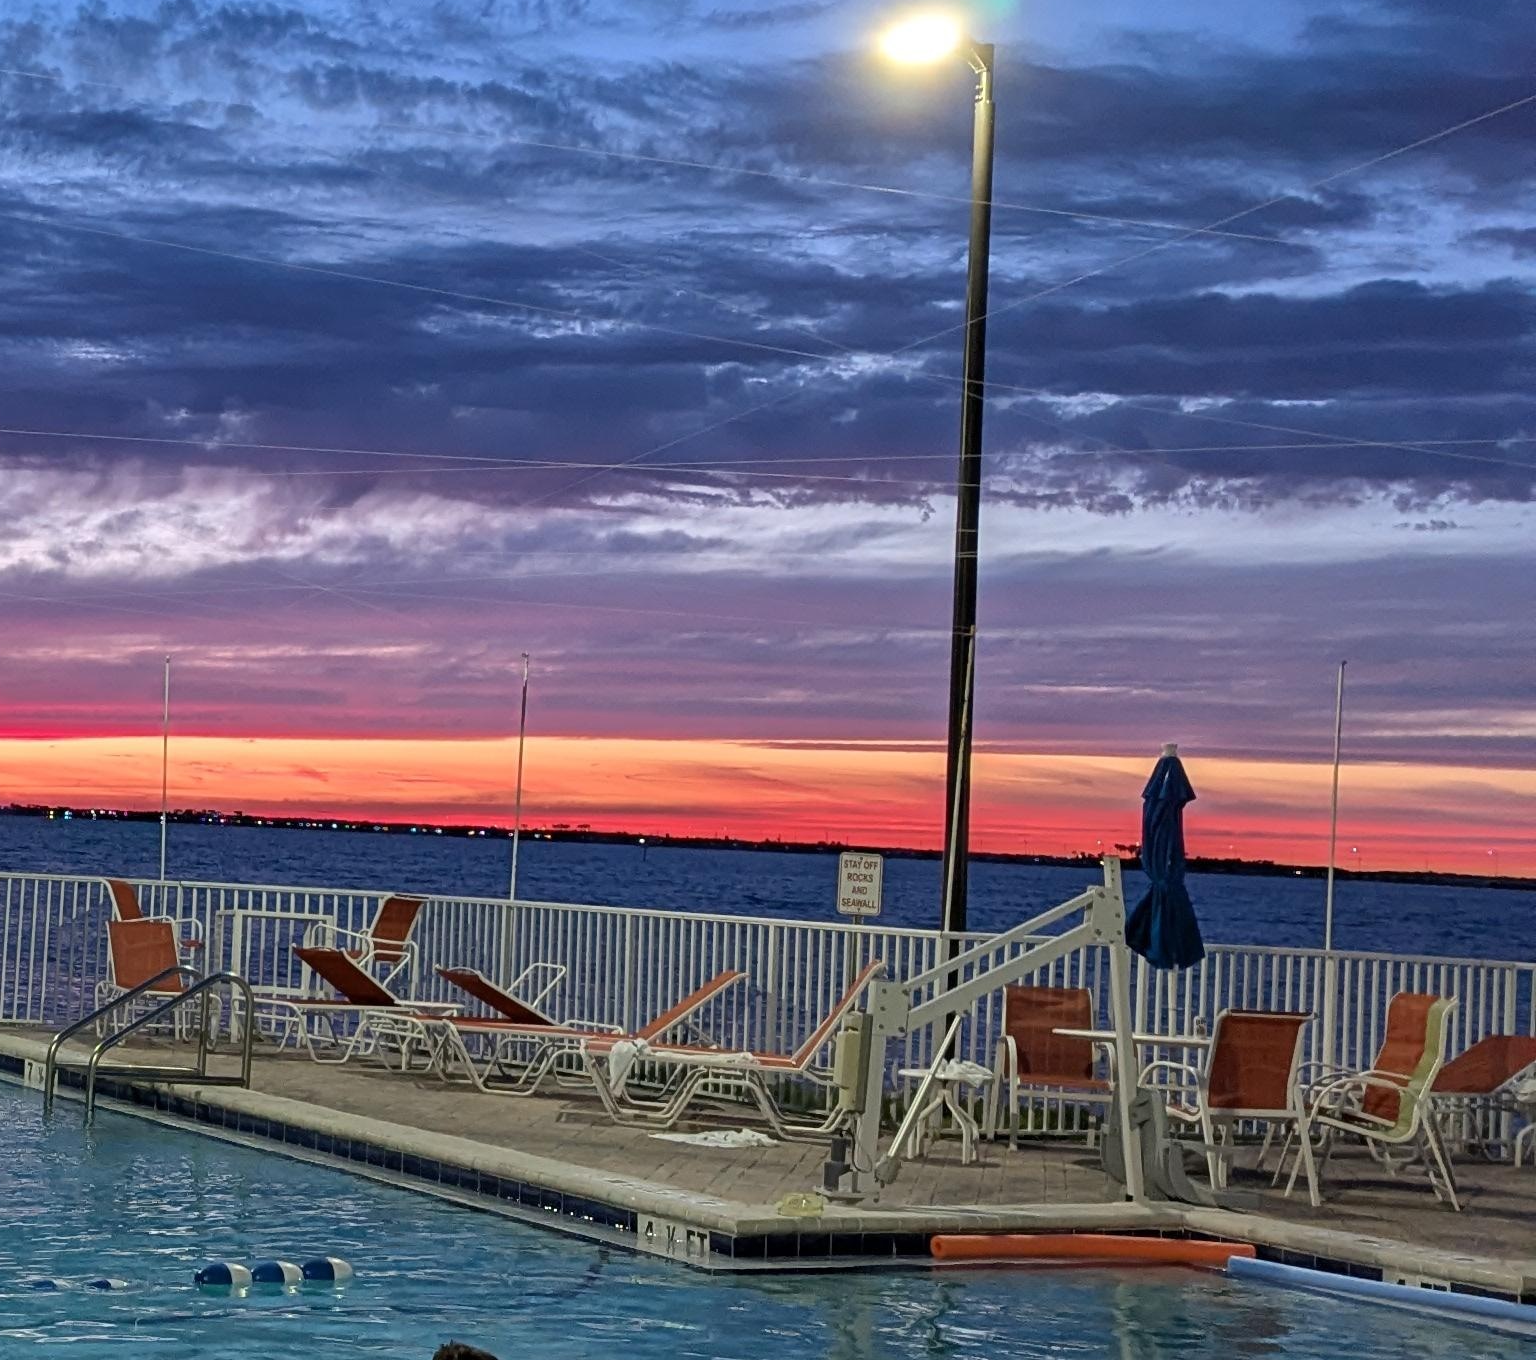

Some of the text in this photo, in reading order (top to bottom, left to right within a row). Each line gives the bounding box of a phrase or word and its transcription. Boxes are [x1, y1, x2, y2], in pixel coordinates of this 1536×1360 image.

[844, 860, 878, 870] STAY OFF
[847, 872, 873, 883] ROCKS
[852, 886, 867, 895] AND
[841, 898, 876, 909] SEAWALL
